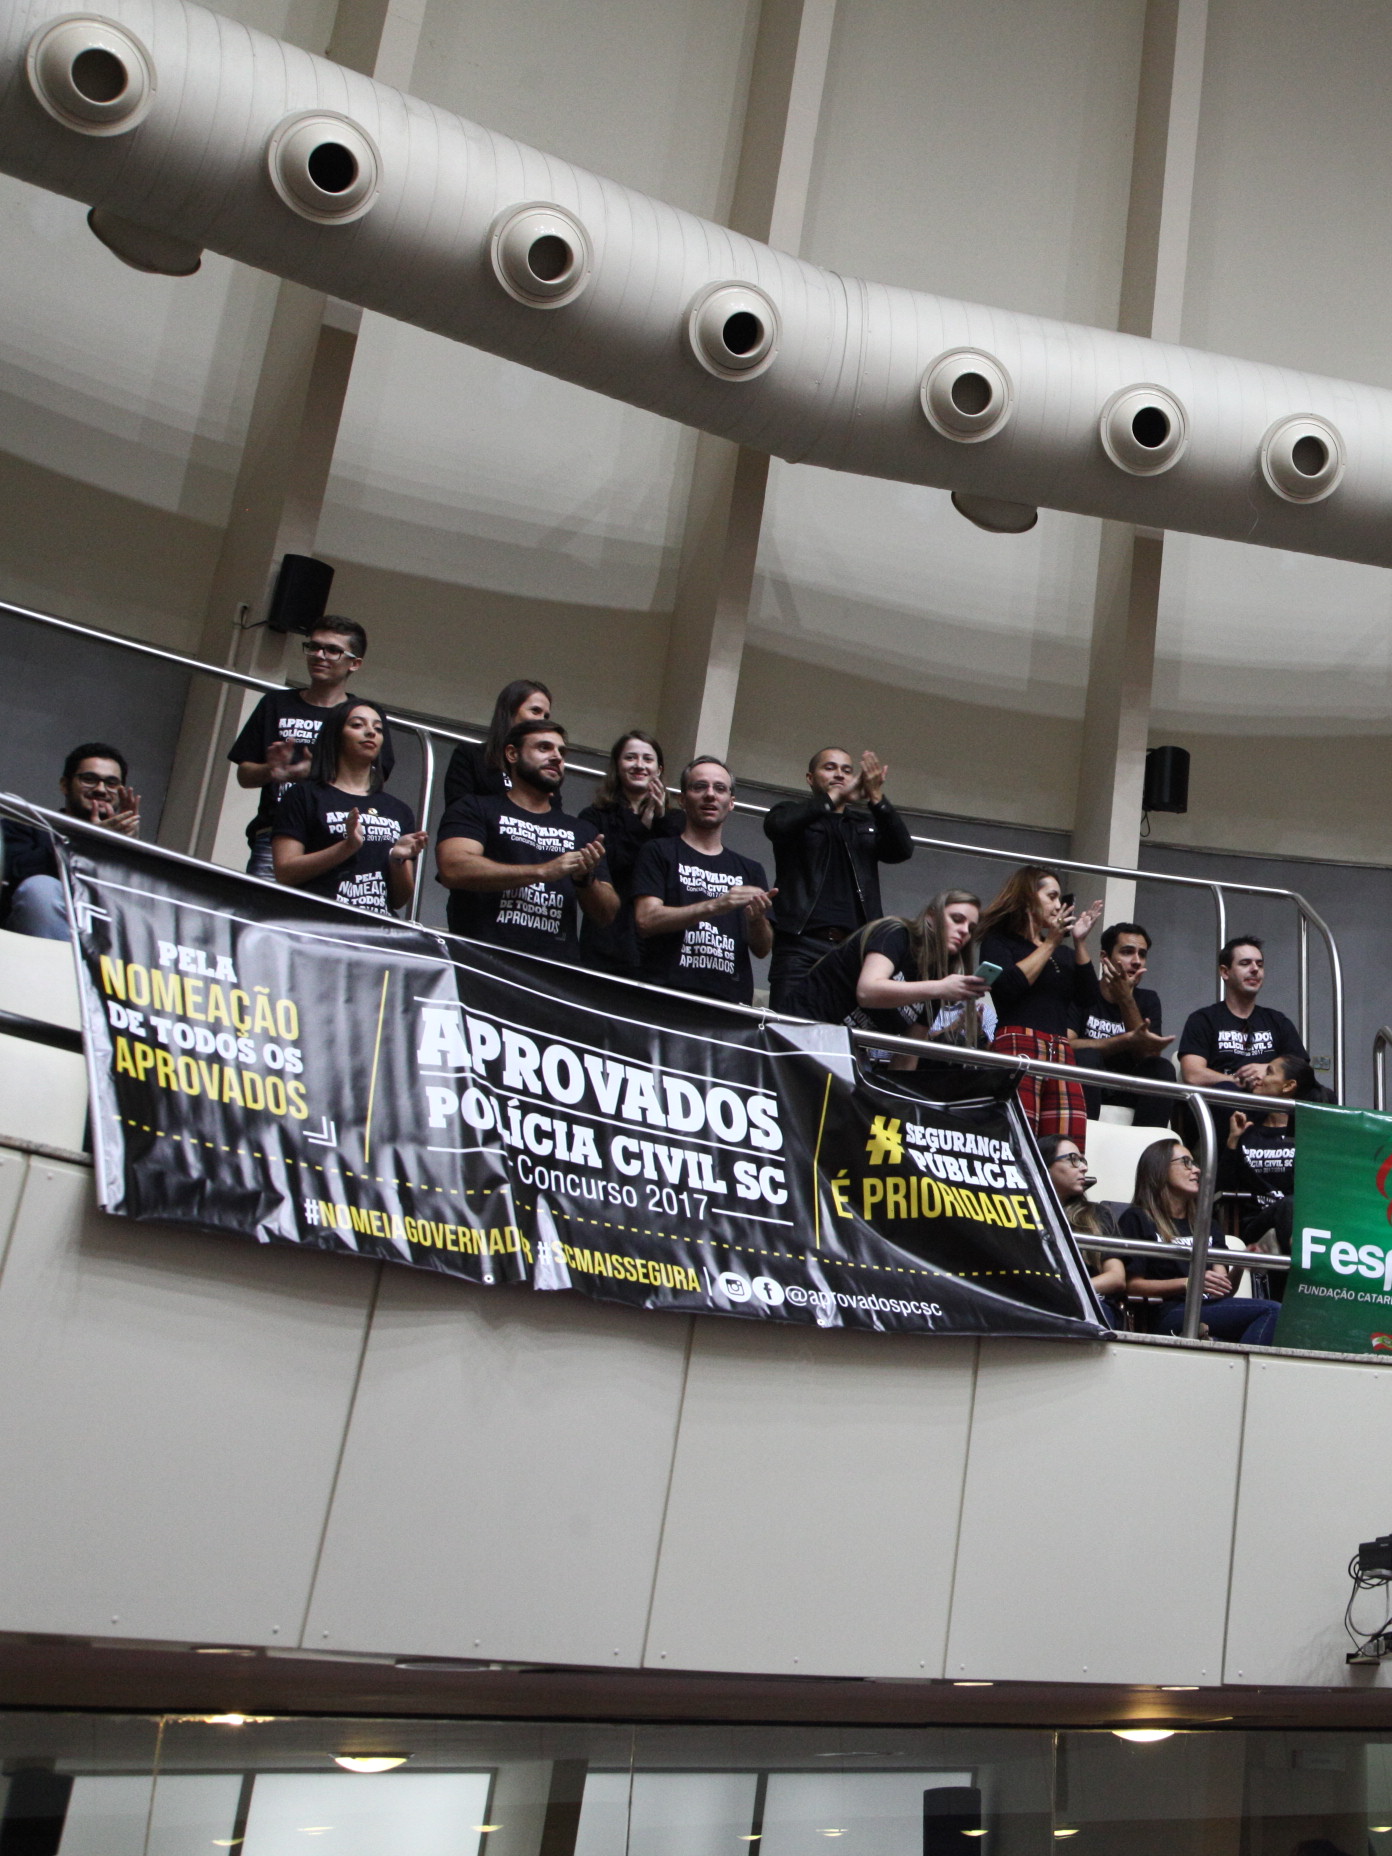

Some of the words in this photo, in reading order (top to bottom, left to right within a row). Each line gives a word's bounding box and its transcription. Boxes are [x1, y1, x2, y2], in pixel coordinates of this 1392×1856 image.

[278, 718, 323, 731] APROV
[499, 815, 576, 841] APROVADOS
[537, 837, 562, 847] CIVIL
[563, 840, 575, 850] SC
[355, 871, 383, 884] PELA
[678, 863, 743, 886] APROVADOS
[351, 894, 386, 908] TODOS
[499, 900, 514, 909] DE
[515, 900, 549, 916] TODOS
[549, 909, 563, 919] OS
[496, 910, 560, 935] APROVADOS
[698, 921, 719, 935] PELA
[158, 940, 237, 983] PELA
[679, 954, 736, 975] APROVADOS
[694, 945, 724, 958] TODOS
[724, 950, 735, 961] OS
[100, 955, 299, 1041] NOMEAÇÃO
[108, 1000, 146, 1038] DE
[150, 1017, 257, 1064] TODOS
[263, 1047, 304, 1074] OS
[116, 1036, 309, 1120] APROVADOS
[417, 1007, 783, 1151] APROVADOS
[425, 1085, 602, 1168] POLÍCIA
[611, 1135, 728, 1194] CIVIL
[733, 1161, 788, 1205] SC
[905, 1122, 1016, 1165] SEGURANÇA
[908, 1147, 1028, 1190] PÚBLICA
[517, 1154, 638, 1208] Concurso
[646, 1185, 708, 1220] 2017
[831, 1169, 854, 1219] É
[862, 1175, 1044, 1230] PRIORIDADE!
[537, 1240, 702, 1293] #SCMAISSEGURA
[785, 1285, 943, 1318] @aprovadospcsc
[1298, 1284, 1355, 1301] FUNDAÇÃO
